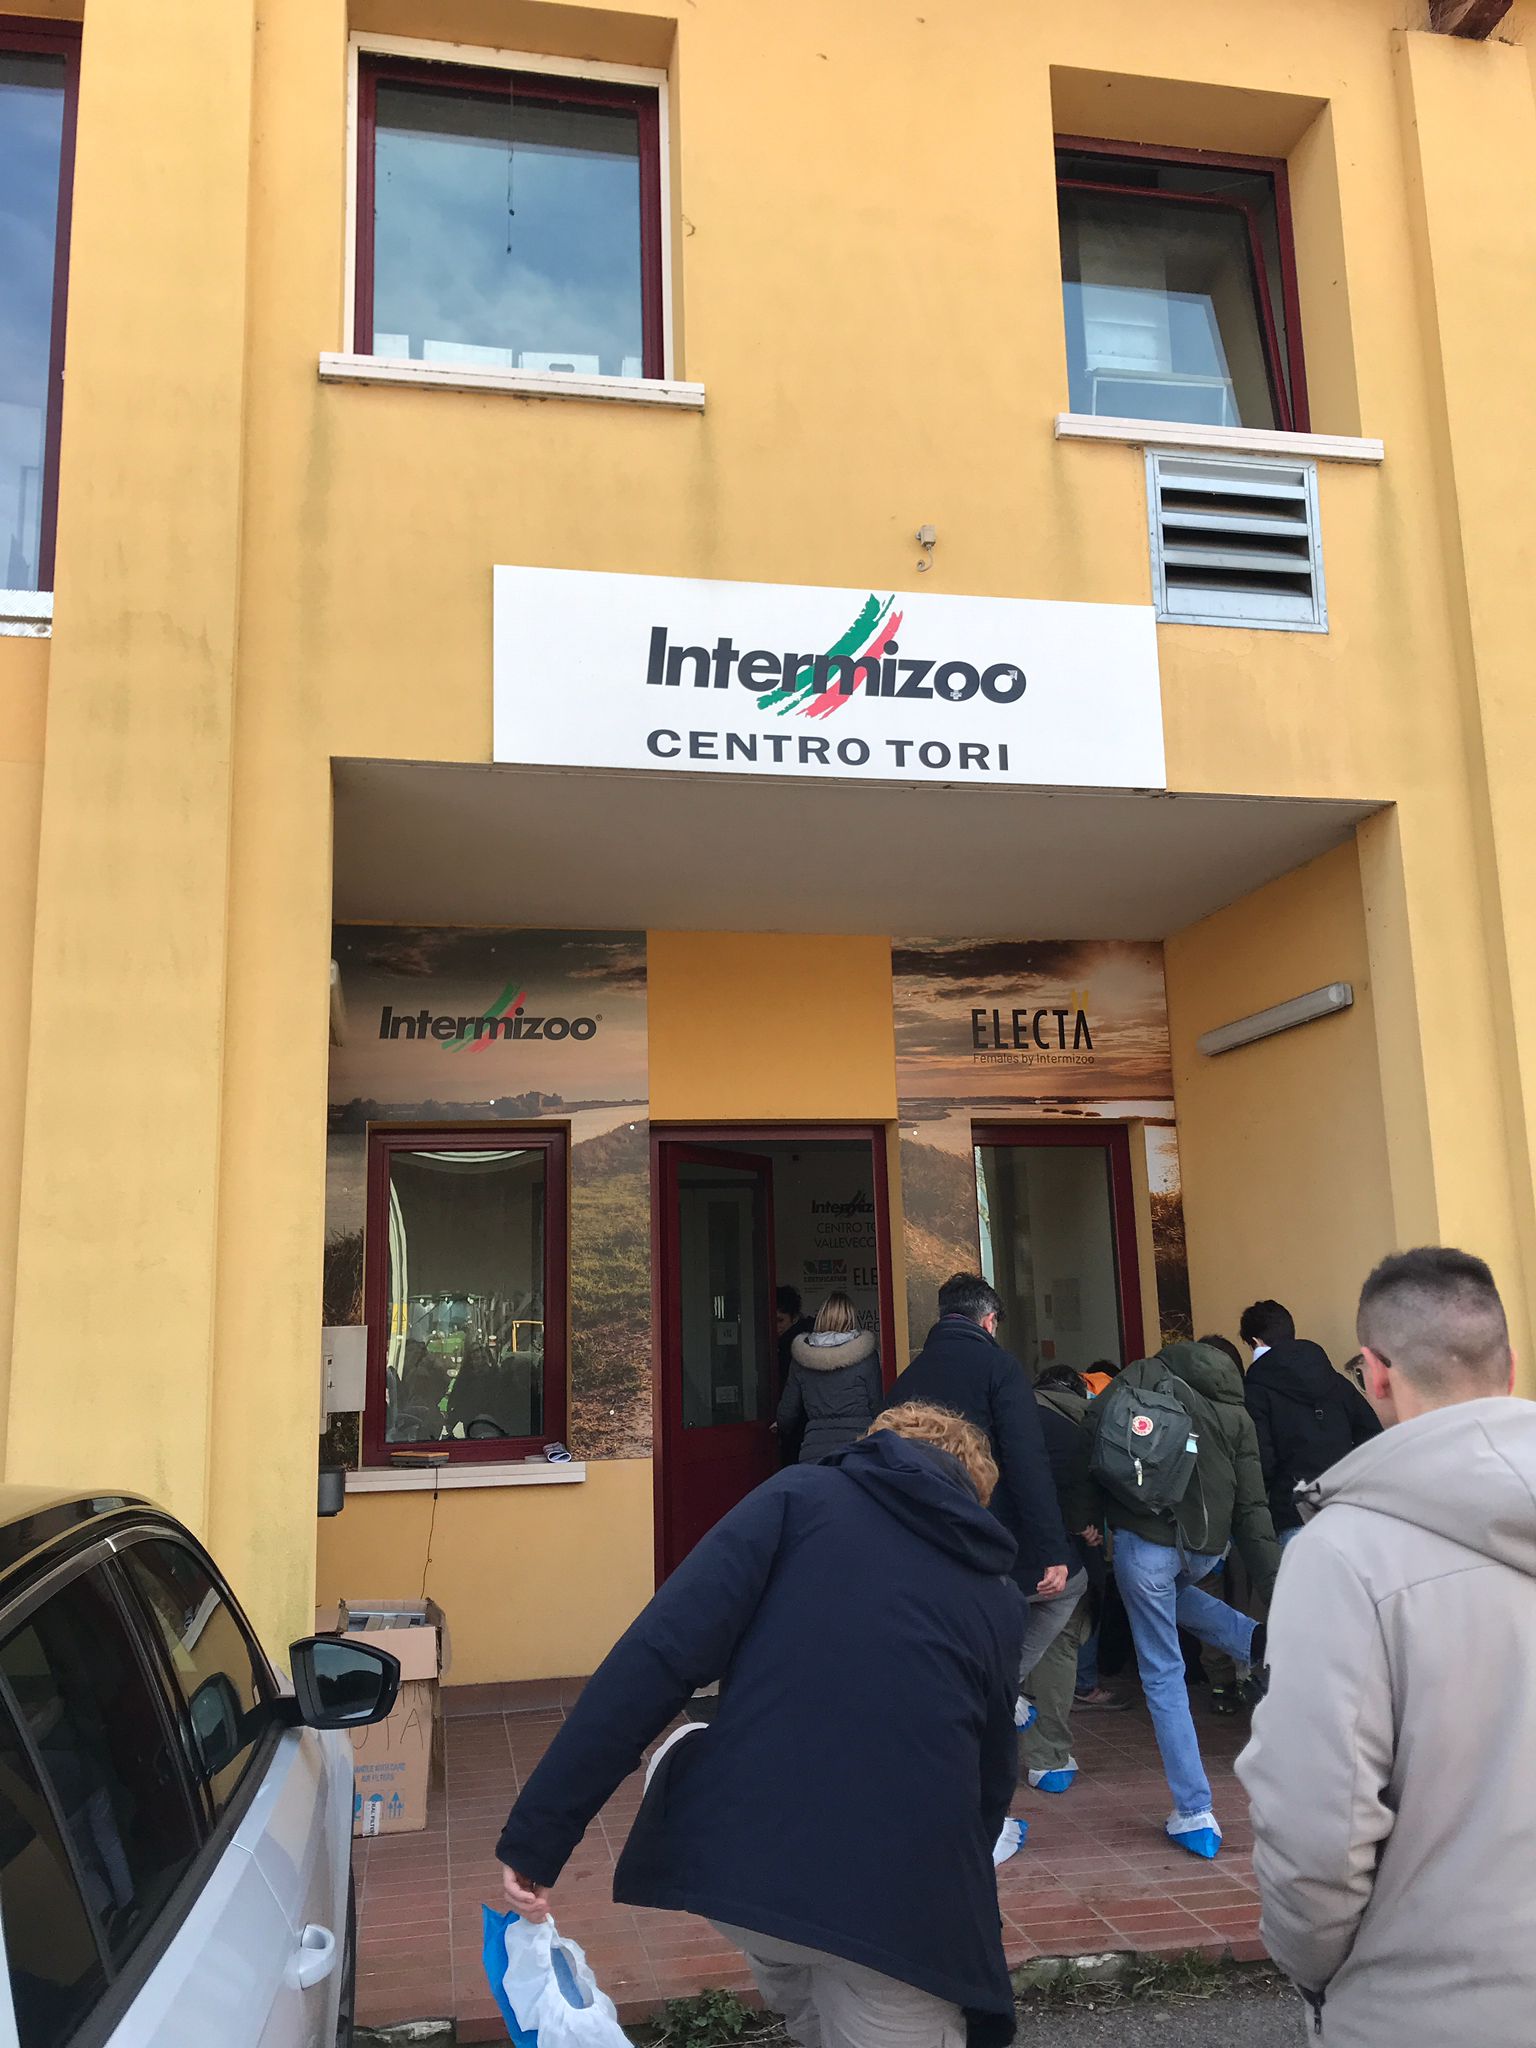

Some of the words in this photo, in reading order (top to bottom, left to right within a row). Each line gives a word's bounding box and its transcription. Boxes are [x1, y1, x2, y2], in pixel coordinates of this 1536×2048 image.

[645, 626, 1027, 704] Intermizoo
[646, 728, 870, 767] CENTRO
[886, 739, 1009, 771] TORI
[379, 1006, 597, 1041] Intermizoo
[971, 1008, 1093, 1050] ELECTA
[973, 1053, 1019, 1064] Females
[1021, 1053, 1033, 1065] by
[1036, 1053, 1094, 1064] Intermizoo
[811, 1199, 874, 1214] Intermiz
[816, 1222, 863, 1234] CENTRO
[814, 1236, 876, 1249] VALLEVECC
[853, 1267, 878, 1285] ELE
[858, 1309, 880, 1320] VAL
